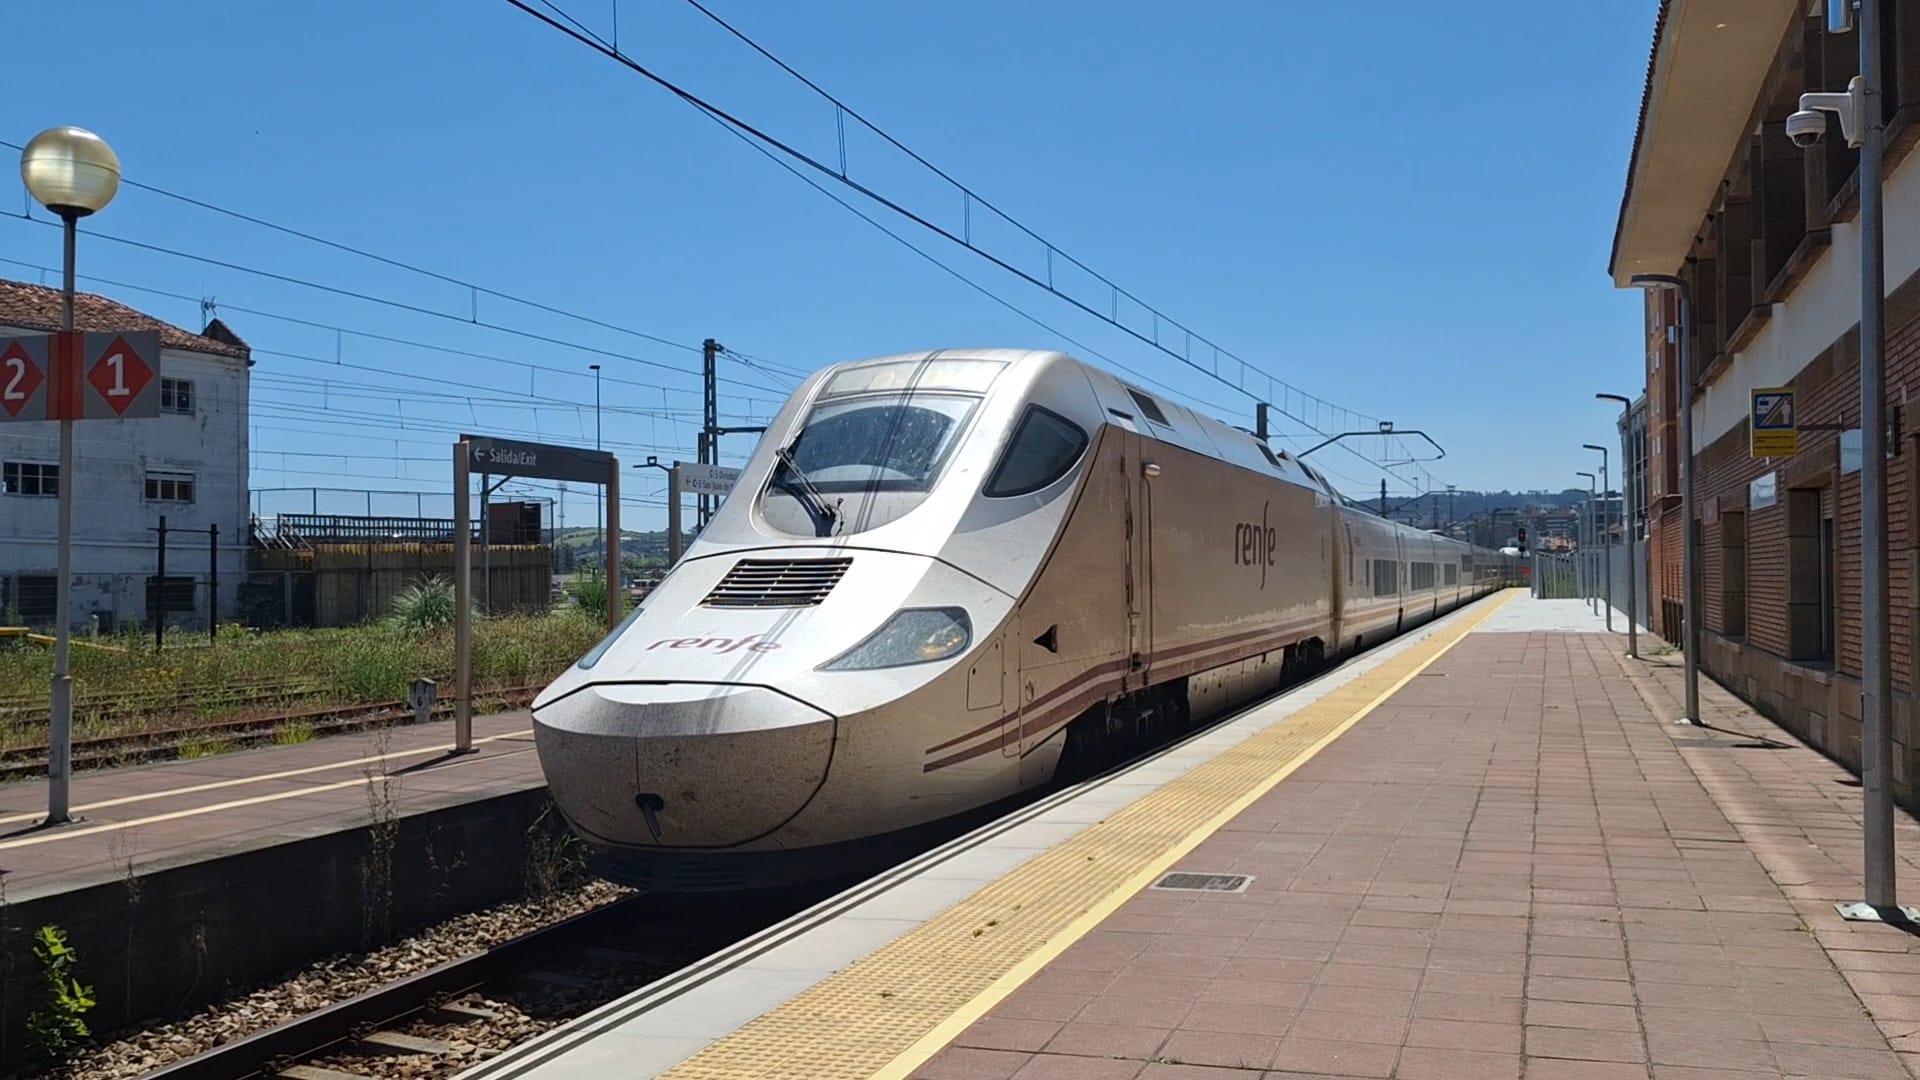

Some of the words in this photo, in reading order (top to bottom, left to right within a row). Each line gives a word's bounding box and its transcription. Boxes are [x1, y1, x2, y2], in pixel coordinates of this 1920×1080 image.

[4, 357, 26, 400] 2
[106, 353, 130, 396] 1
[489, 448, 537, 466] Salida/Exit
[1235, 499, 1276, 590] renfe
[645, 633, 782, 656] renfe
